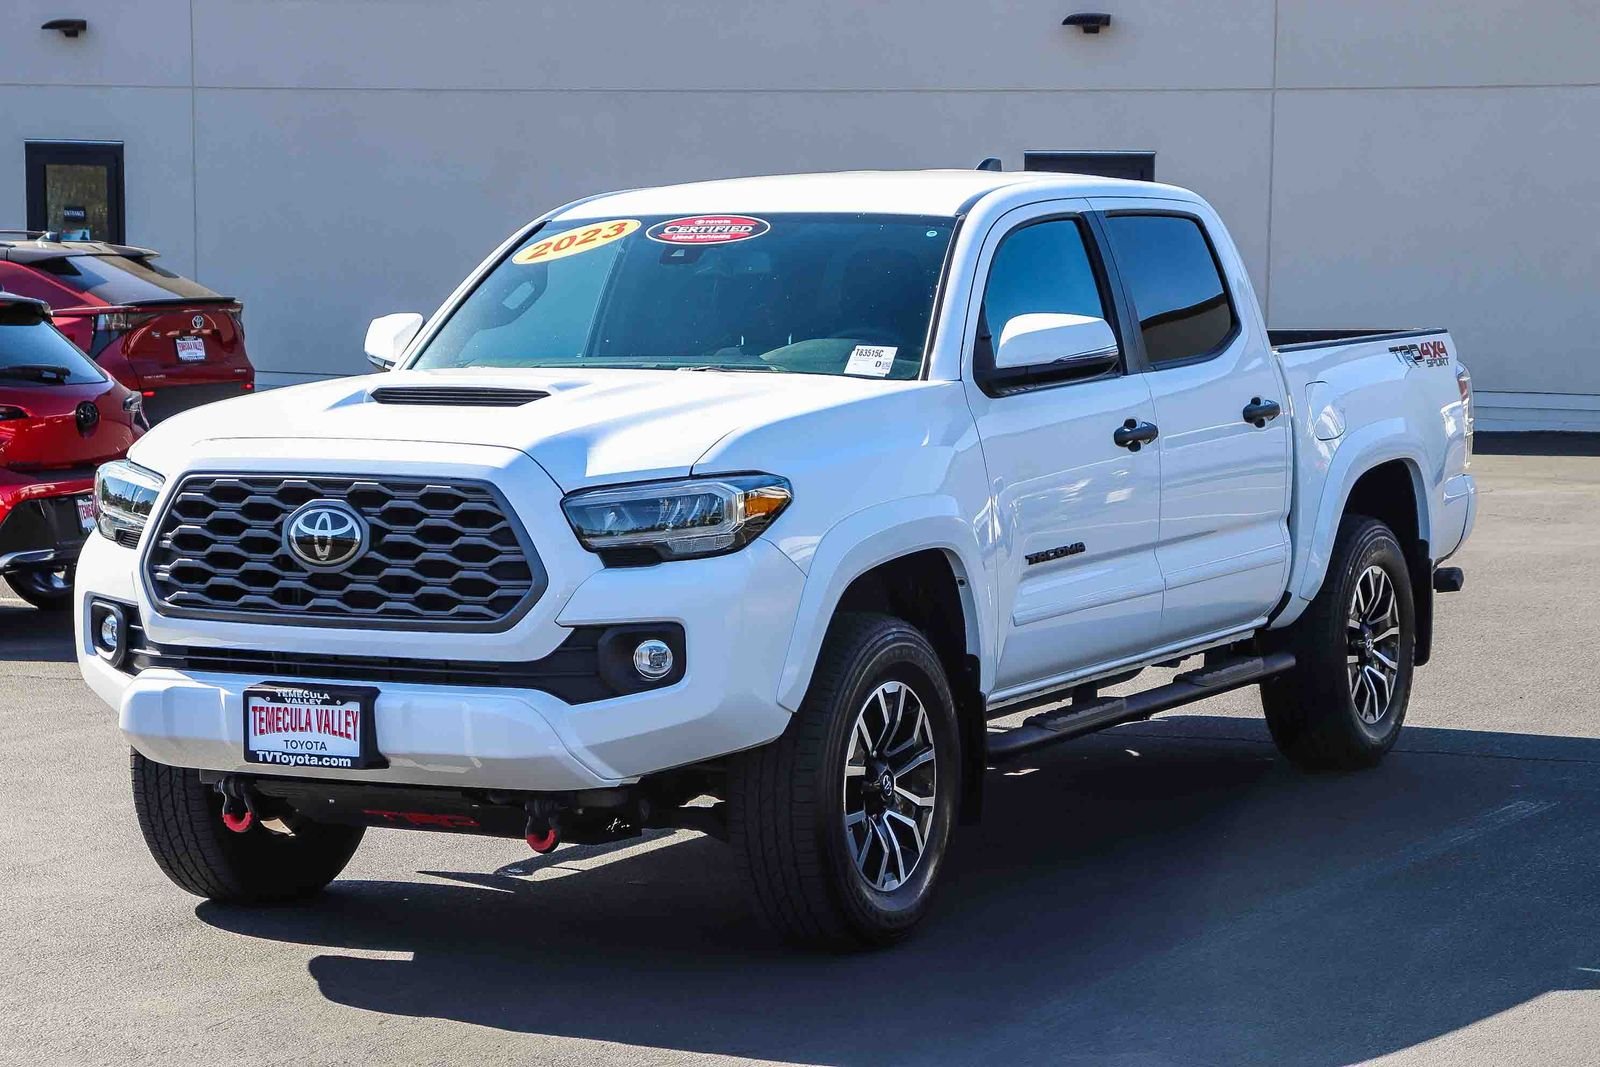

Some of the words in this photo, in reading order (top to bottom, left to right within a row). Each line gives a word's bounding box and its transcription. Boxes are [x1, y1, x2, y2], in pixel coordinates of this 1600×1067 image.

[664, 225, 753, 233] CERTIFIED
[527, 222, 627, 259] 2023
[1388, 344, 1424, 368] TRD
[1426, 358, 1449, 367] SPORT
[1025, 542, 1085, 565] TACOMA
[277, 690, 330, 699] TEMECULA
[252, 706, 312, 736] TEMECULA
[316, 709, 359, 741] VALLEY
[284, 740, 327, 751] TOYOTA
[257, 751, 351, 767] TVToyota.com
